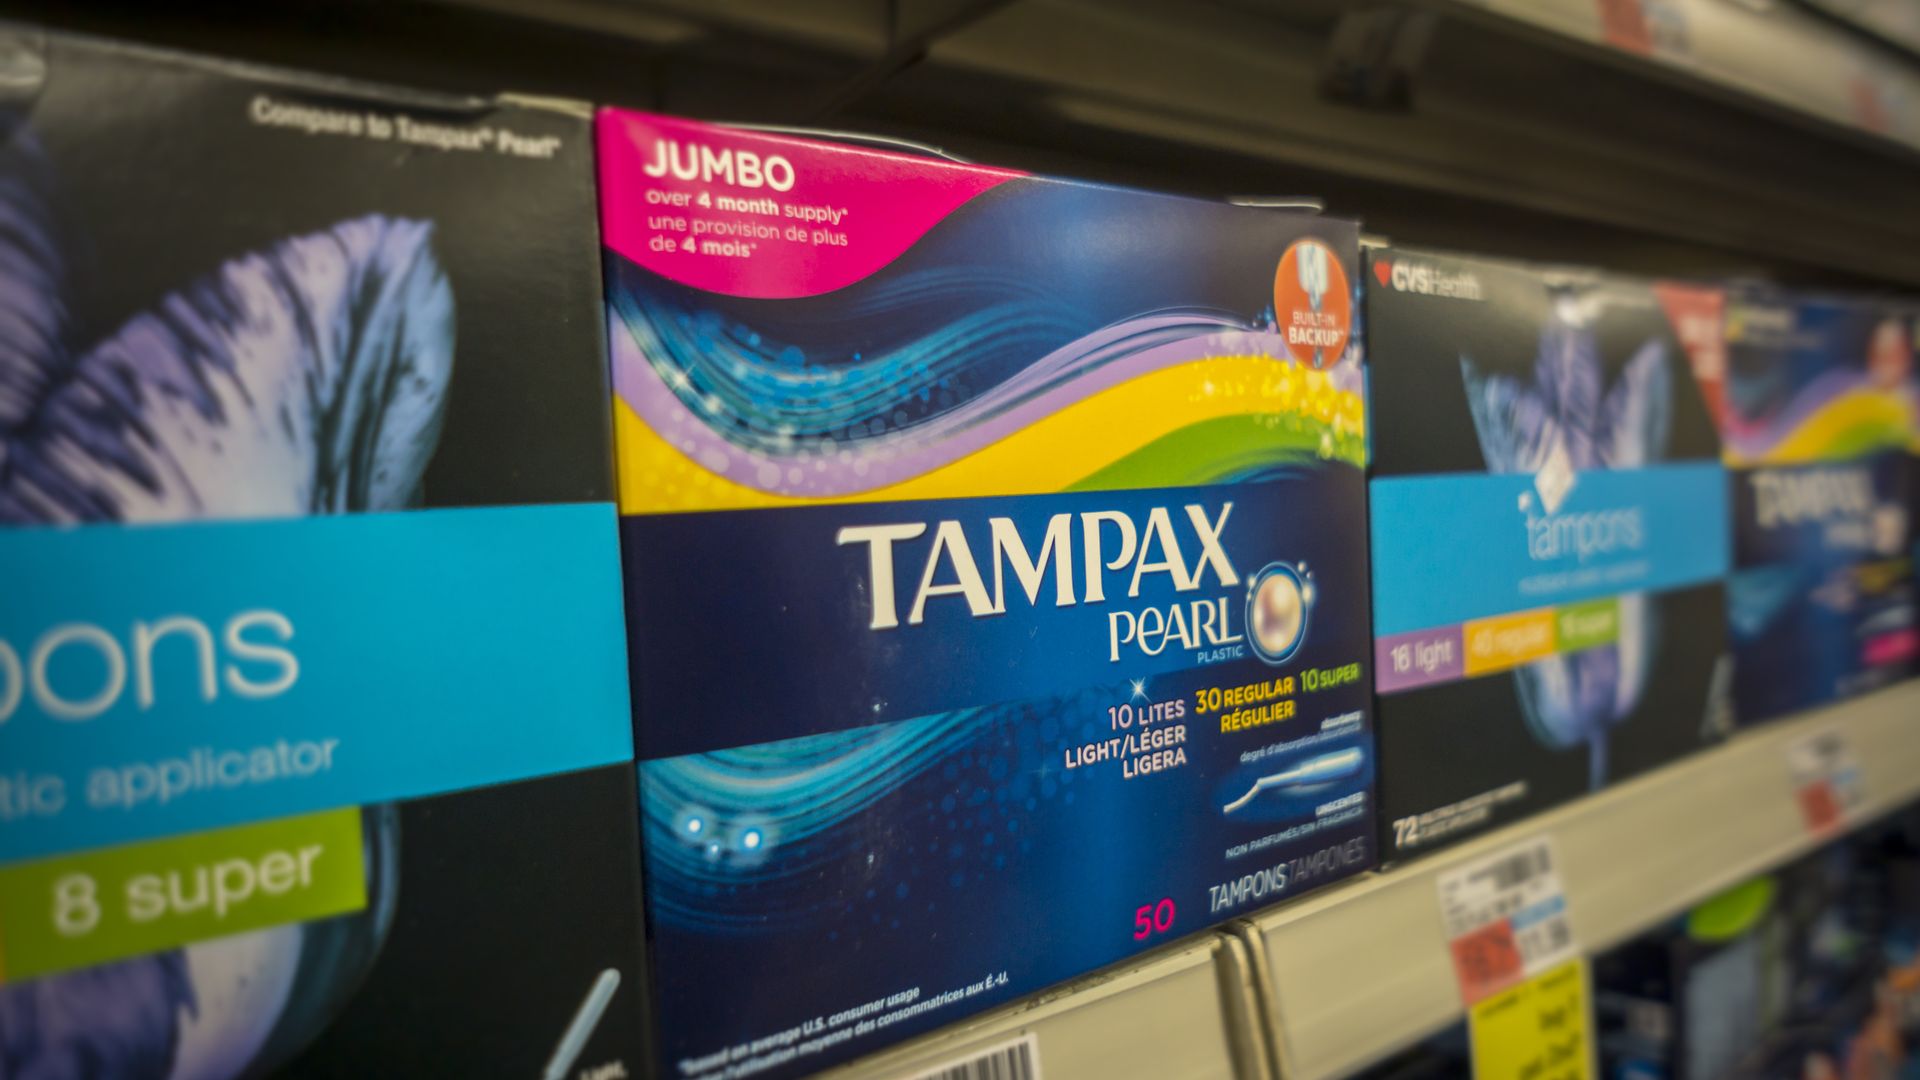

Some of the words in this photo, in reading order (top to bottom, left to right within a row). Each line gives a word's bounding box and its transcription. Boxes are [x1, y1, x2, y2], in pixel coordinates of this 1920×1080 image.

[250, 97, 362, 134] Compare
[367, 114, 392, 138] to
[644, 140, 795, 192] JUMBO
[646, 190, 691, 206] over
[697, 192, 711, 208] 4
[716, 196, 779, 216] month
[648, 216, 687, 231] une
[693, 218, 780, 239] provision
[785, 226, 807, 242] de
[813, 230, 847, 246] plus
[650, 235, 675, 252] de
[681, 238, 696, 253] 4
[1293, 310, 1336, 326] BUILT-IN
[1526, 507, 1642, 562] tampons
[836, 502, 1240, 630] TAMPAX
[1197, 645, 1243, 664] PLASTIC
[1415, 639, 1453, 675] light
[1300, 669, 1318, 692] 10
[1319, 662, 1360, 687] SUPER
[1195, 687, 1221, 715] 30
[1224, 676, 1295, 707] REGULAR
[1109, 703, 1132, 730] 10
[1139, 699, 1186, 726] LITES
[1221, 700, 1296, 733] RÉGULIER
[1065, 725, 1186, 769] LIGHT/LÉGER
[1123, 747, 1187, 779] LIGERA
[1240, 746, 1265, 763] degré
[87, 739, 340, 810] applicator
[1393, 815, 1418, 848] 72
[1225, 843, 1249, 859] NON
[53, 873, 101, 936] 8
[126, 845, 323, 922] super
[1209, 863, 1287, 912] TAMPONS
[1133, 897, 1176, 940] 50
[751, 1027, 801, 1054] average
[803, 1016, 827, 1036] U.S.
[828, 998, 885, 1027] consumer
[887, 986, 920, 1008] usage
[798, 1026, 852, 1055] moyenne
[855, 1019, 876, 1036] des
[877, 988, 964, 1027] consommatrices
[966, 982, 984, 997] aux
[985, 971, 1009, 990] É.-U.
